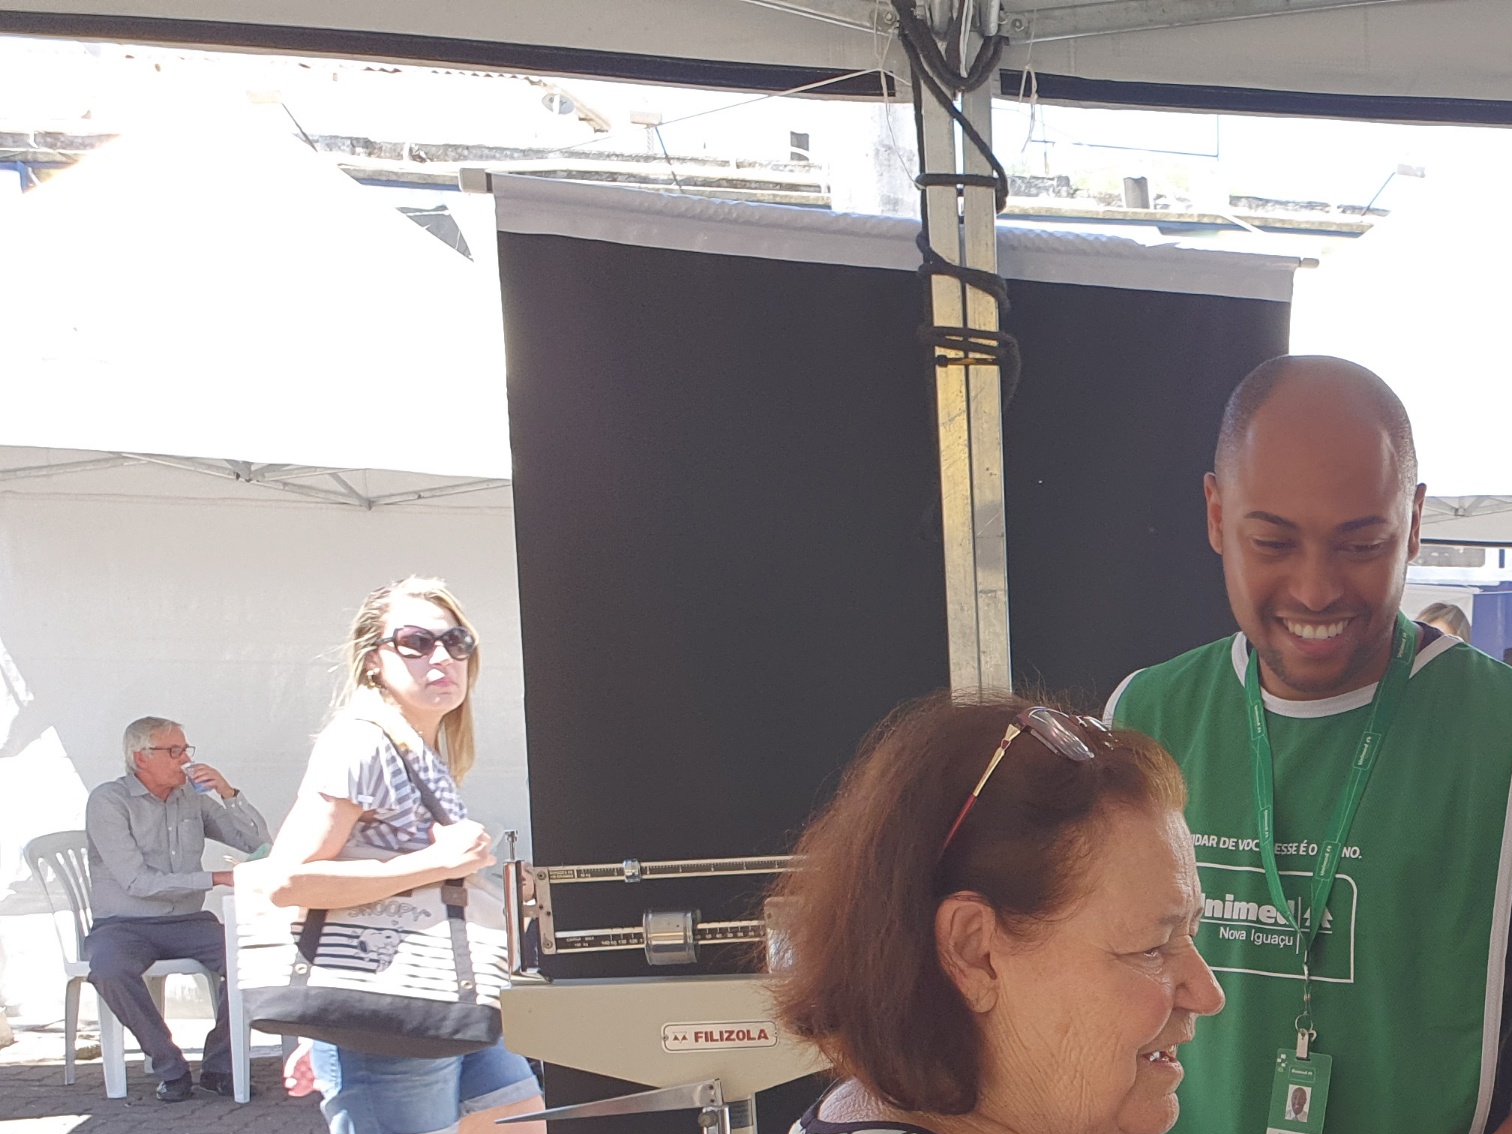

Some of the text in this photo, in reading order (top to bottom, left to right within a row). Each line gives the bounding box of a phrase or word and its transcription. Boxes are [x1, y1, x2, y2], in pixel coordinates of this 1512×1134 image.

[1219, 837, 1236, 850] DE
[1238, 838, 1260, 851] VOC
[1274, 843, 1297, 855] ESSE
[1299, 839, 1309, 855] É
[1308, 843, 1318, 855] O
[1219, 926, 1294, 948] Nova Iguaçu
[694, 1028, 769, 1043] FILIZOLA
